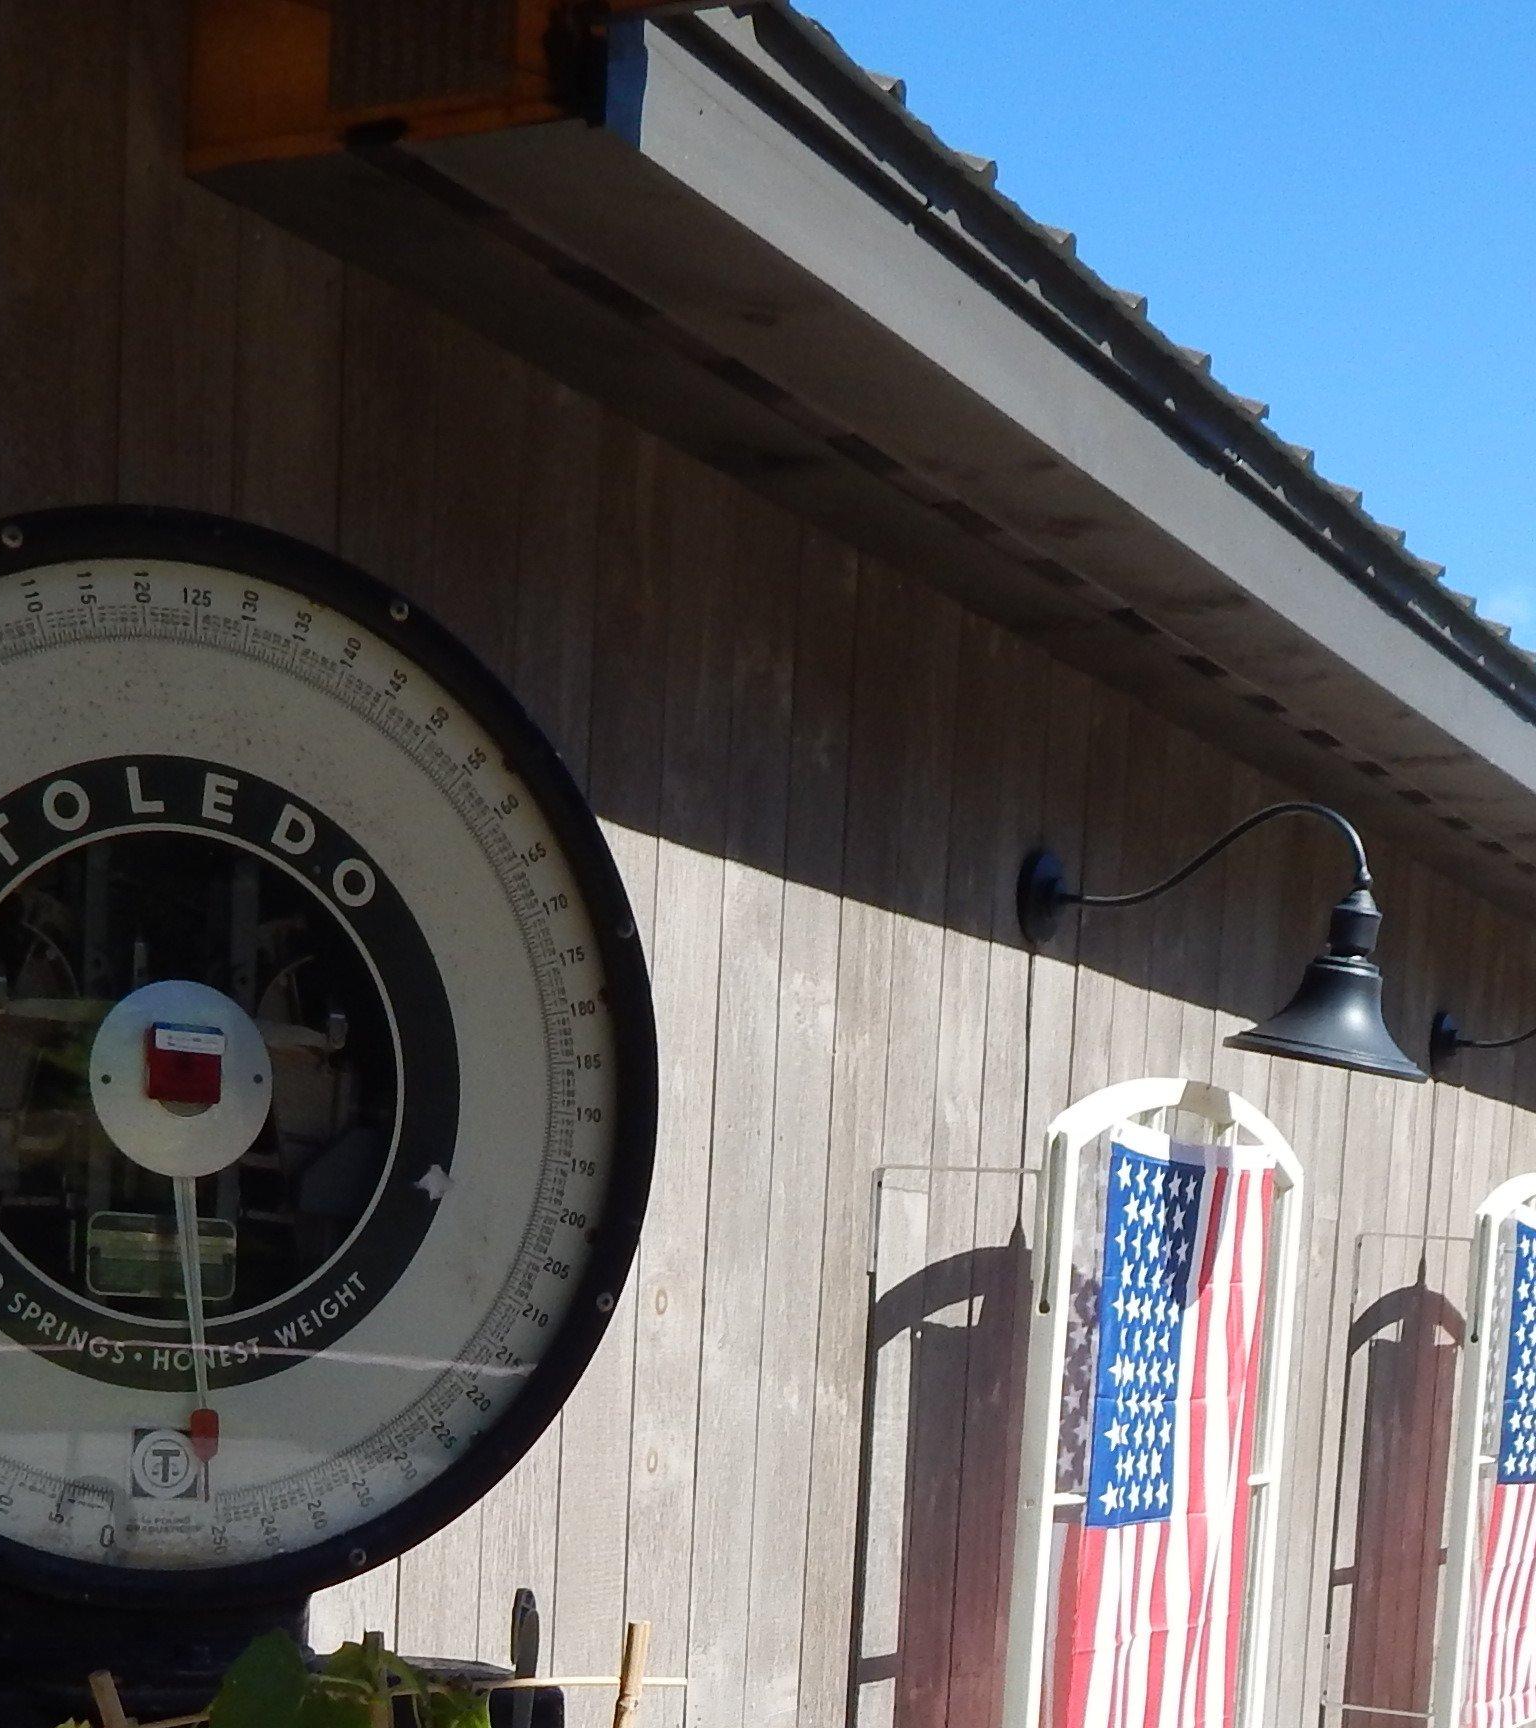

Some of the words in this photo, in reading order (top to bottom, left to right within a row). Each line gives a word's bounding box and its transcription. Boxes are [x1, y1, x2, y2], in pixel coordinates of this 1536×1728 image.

[20, 579, 44, 614] 110
[76, 571, 98, 606] 115
[133, 571, 152, 604] 120
[182, 587, 213, 608] 125
[241, 590, 260, 622] 130
[293, 610, 313, 642] 135
[340, 637, 363, 668] 140
[384, 668, 408, 700] 145
[493, 794, 520, 819] 160
[520, 841, 547, 867] 165
[542, 893, 568, 916] 170
[559, 946, 586, 966] 175
[570, 1000, 596, 1018] 180
[576, 1053, 602, 1070] 185
[576, 1107, 602, 1124] 190
[571, 1158, 596, 1177] 195
[559, 1208, 586, 1229] 200
[543, 1256, 570, 1281] 205
[7, 1292, 125, 1365] SPRINGS
[152, 1336, 261, 1371] HONEST
[274, 1271, 367, 1348] WEIGHT
[522, 1303, 549, 1328] 210
[466, 1384, 492, 1412] 220
[431, 1420, 457, 1450] 225
[152, 1449, 181, 1483] T
[100, 1524, 114, 1548] 0
